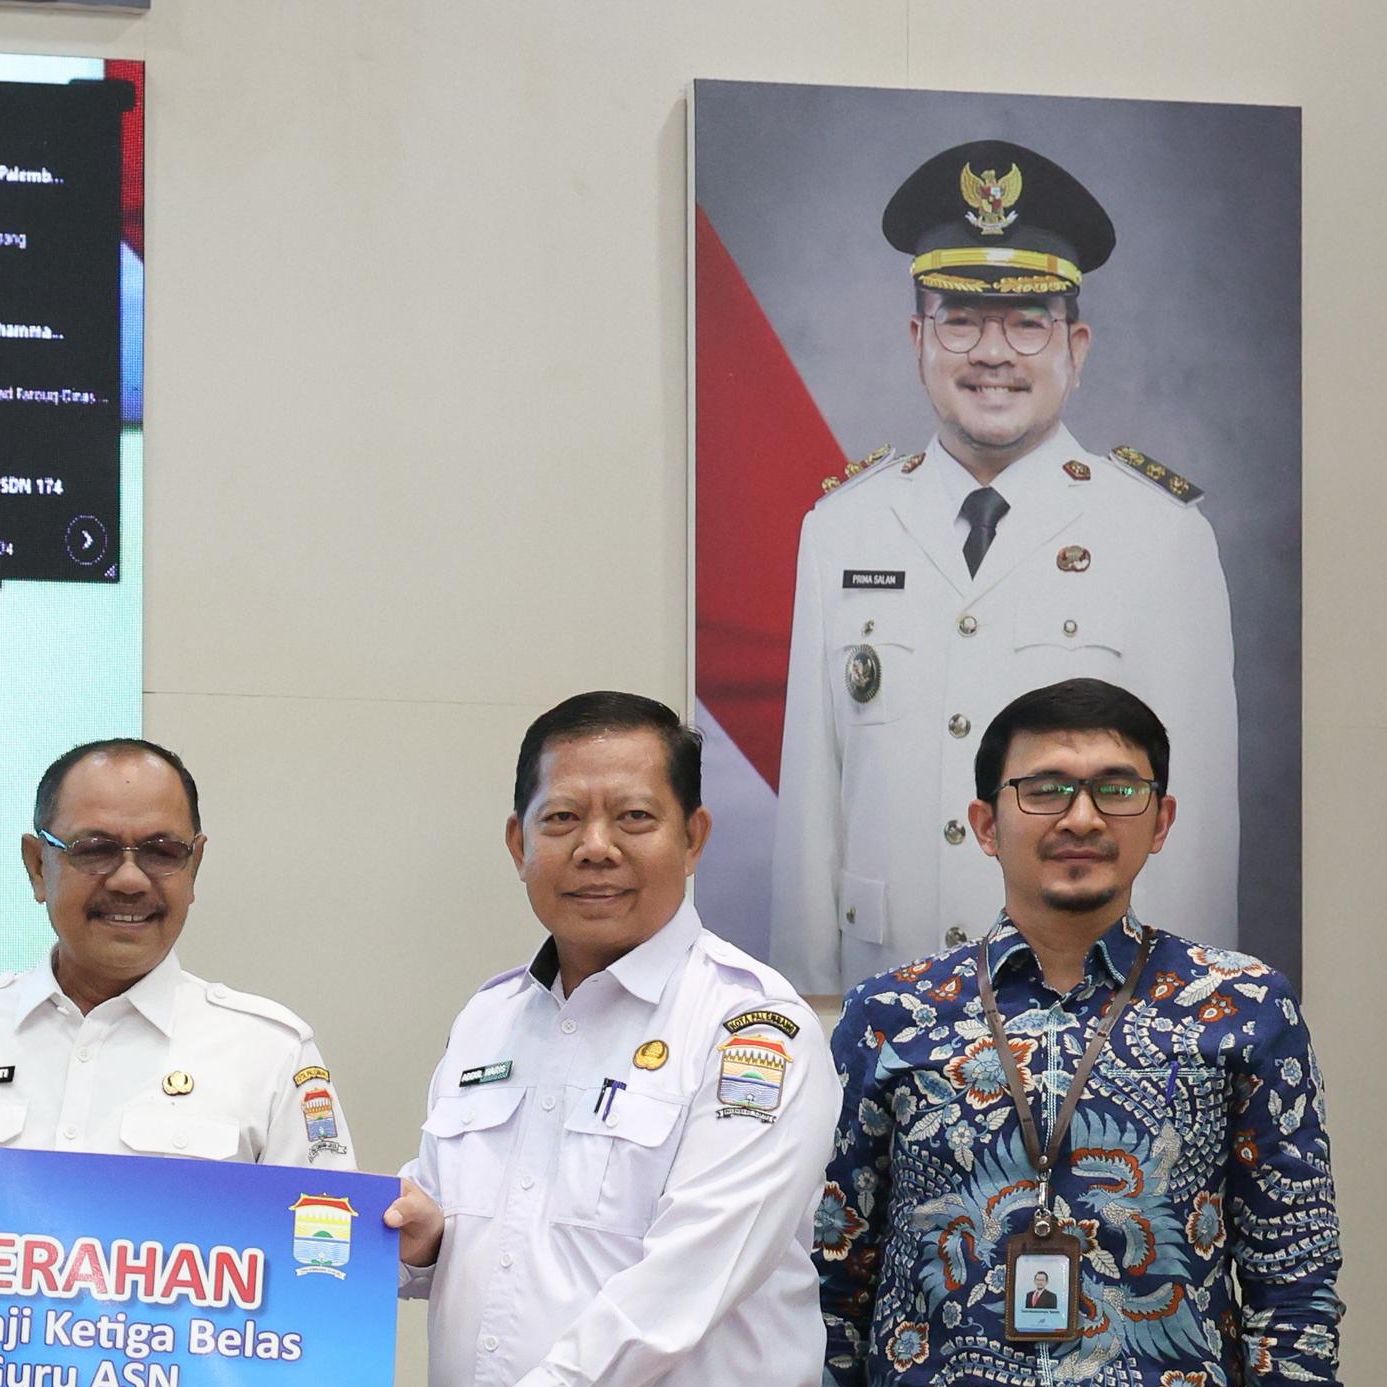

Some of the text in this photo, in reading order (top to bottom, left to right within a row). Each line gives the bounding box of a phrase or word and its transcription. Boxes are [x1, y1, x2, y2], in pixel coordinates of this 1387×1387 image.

[0, 475, 32, 495] SDN
[36, 477, 64, 495] 174
[727, 1013, 753, 1031] KOTA
[44, 1309, 175, 1358] Ketiga
[189, 1321, 303, 1362] Belas
